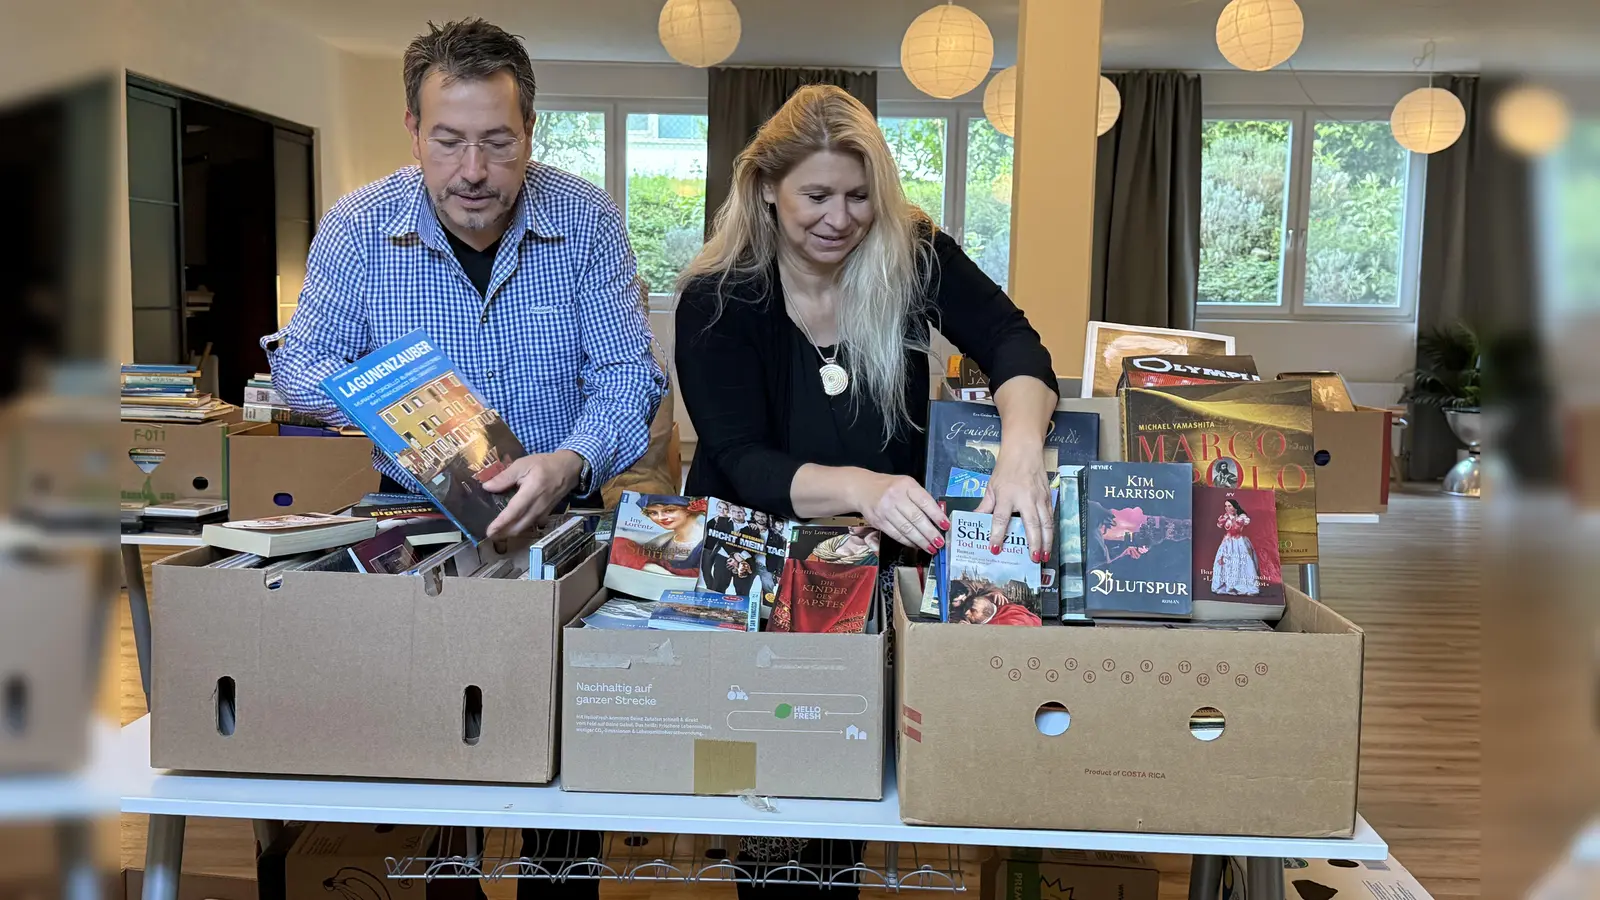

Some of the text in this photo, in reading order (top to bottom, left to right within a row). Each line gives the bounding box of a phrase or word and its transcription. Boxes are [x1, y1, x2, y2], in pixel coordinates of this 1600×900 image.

[338, 341, 433, 398] LAGUNENZAUBER
[1138, 421, 1215, 431] MICHAEL YAMASHITA
[134, 428, 166, 442] F-011
[1137, 429, 1286, 463] MARCO
[1193, 456, 1307, 493] OLO
[1127, 475, 1154, 487] KIM
[1104, 486, 1175, 499] HARRISON
[370, 506, 433, 518] Eigentor
[624, 520, 654, 531] Lorentz
[629, 516, 643, 525] Iny
[958, 519, 984, 528] Frank
[802, 528, 813, 537] Iny
[814, 528, 839, 537] Lorentz
[957, 526, 1030, 550] Schzin
[766, 545, 786, 557] TAG
[956, 540, 973, 549] Tod
[1003, 545, 1023, 555] eufel
[820, 579, 836, 587] DIE
[1090, 569, 1188, 596] BLUTSPUR
[802, 584, 849, 595] KINDER
[797, 597, 846, 609] PAPSTES
[994, 658, 1266, 673] 1 3 5 7 9 11 13 15
[1013, 671, 1247, 684] 2 4 6 8 10 12 14
[576, 682, 653, 695] Nachhaltig auf
[576, 695, 657, 706] ganzer Strecke
[793, 712, 821, 720] FRESH
[1084, 768, 1166, 779] Product of COSTA RICA
